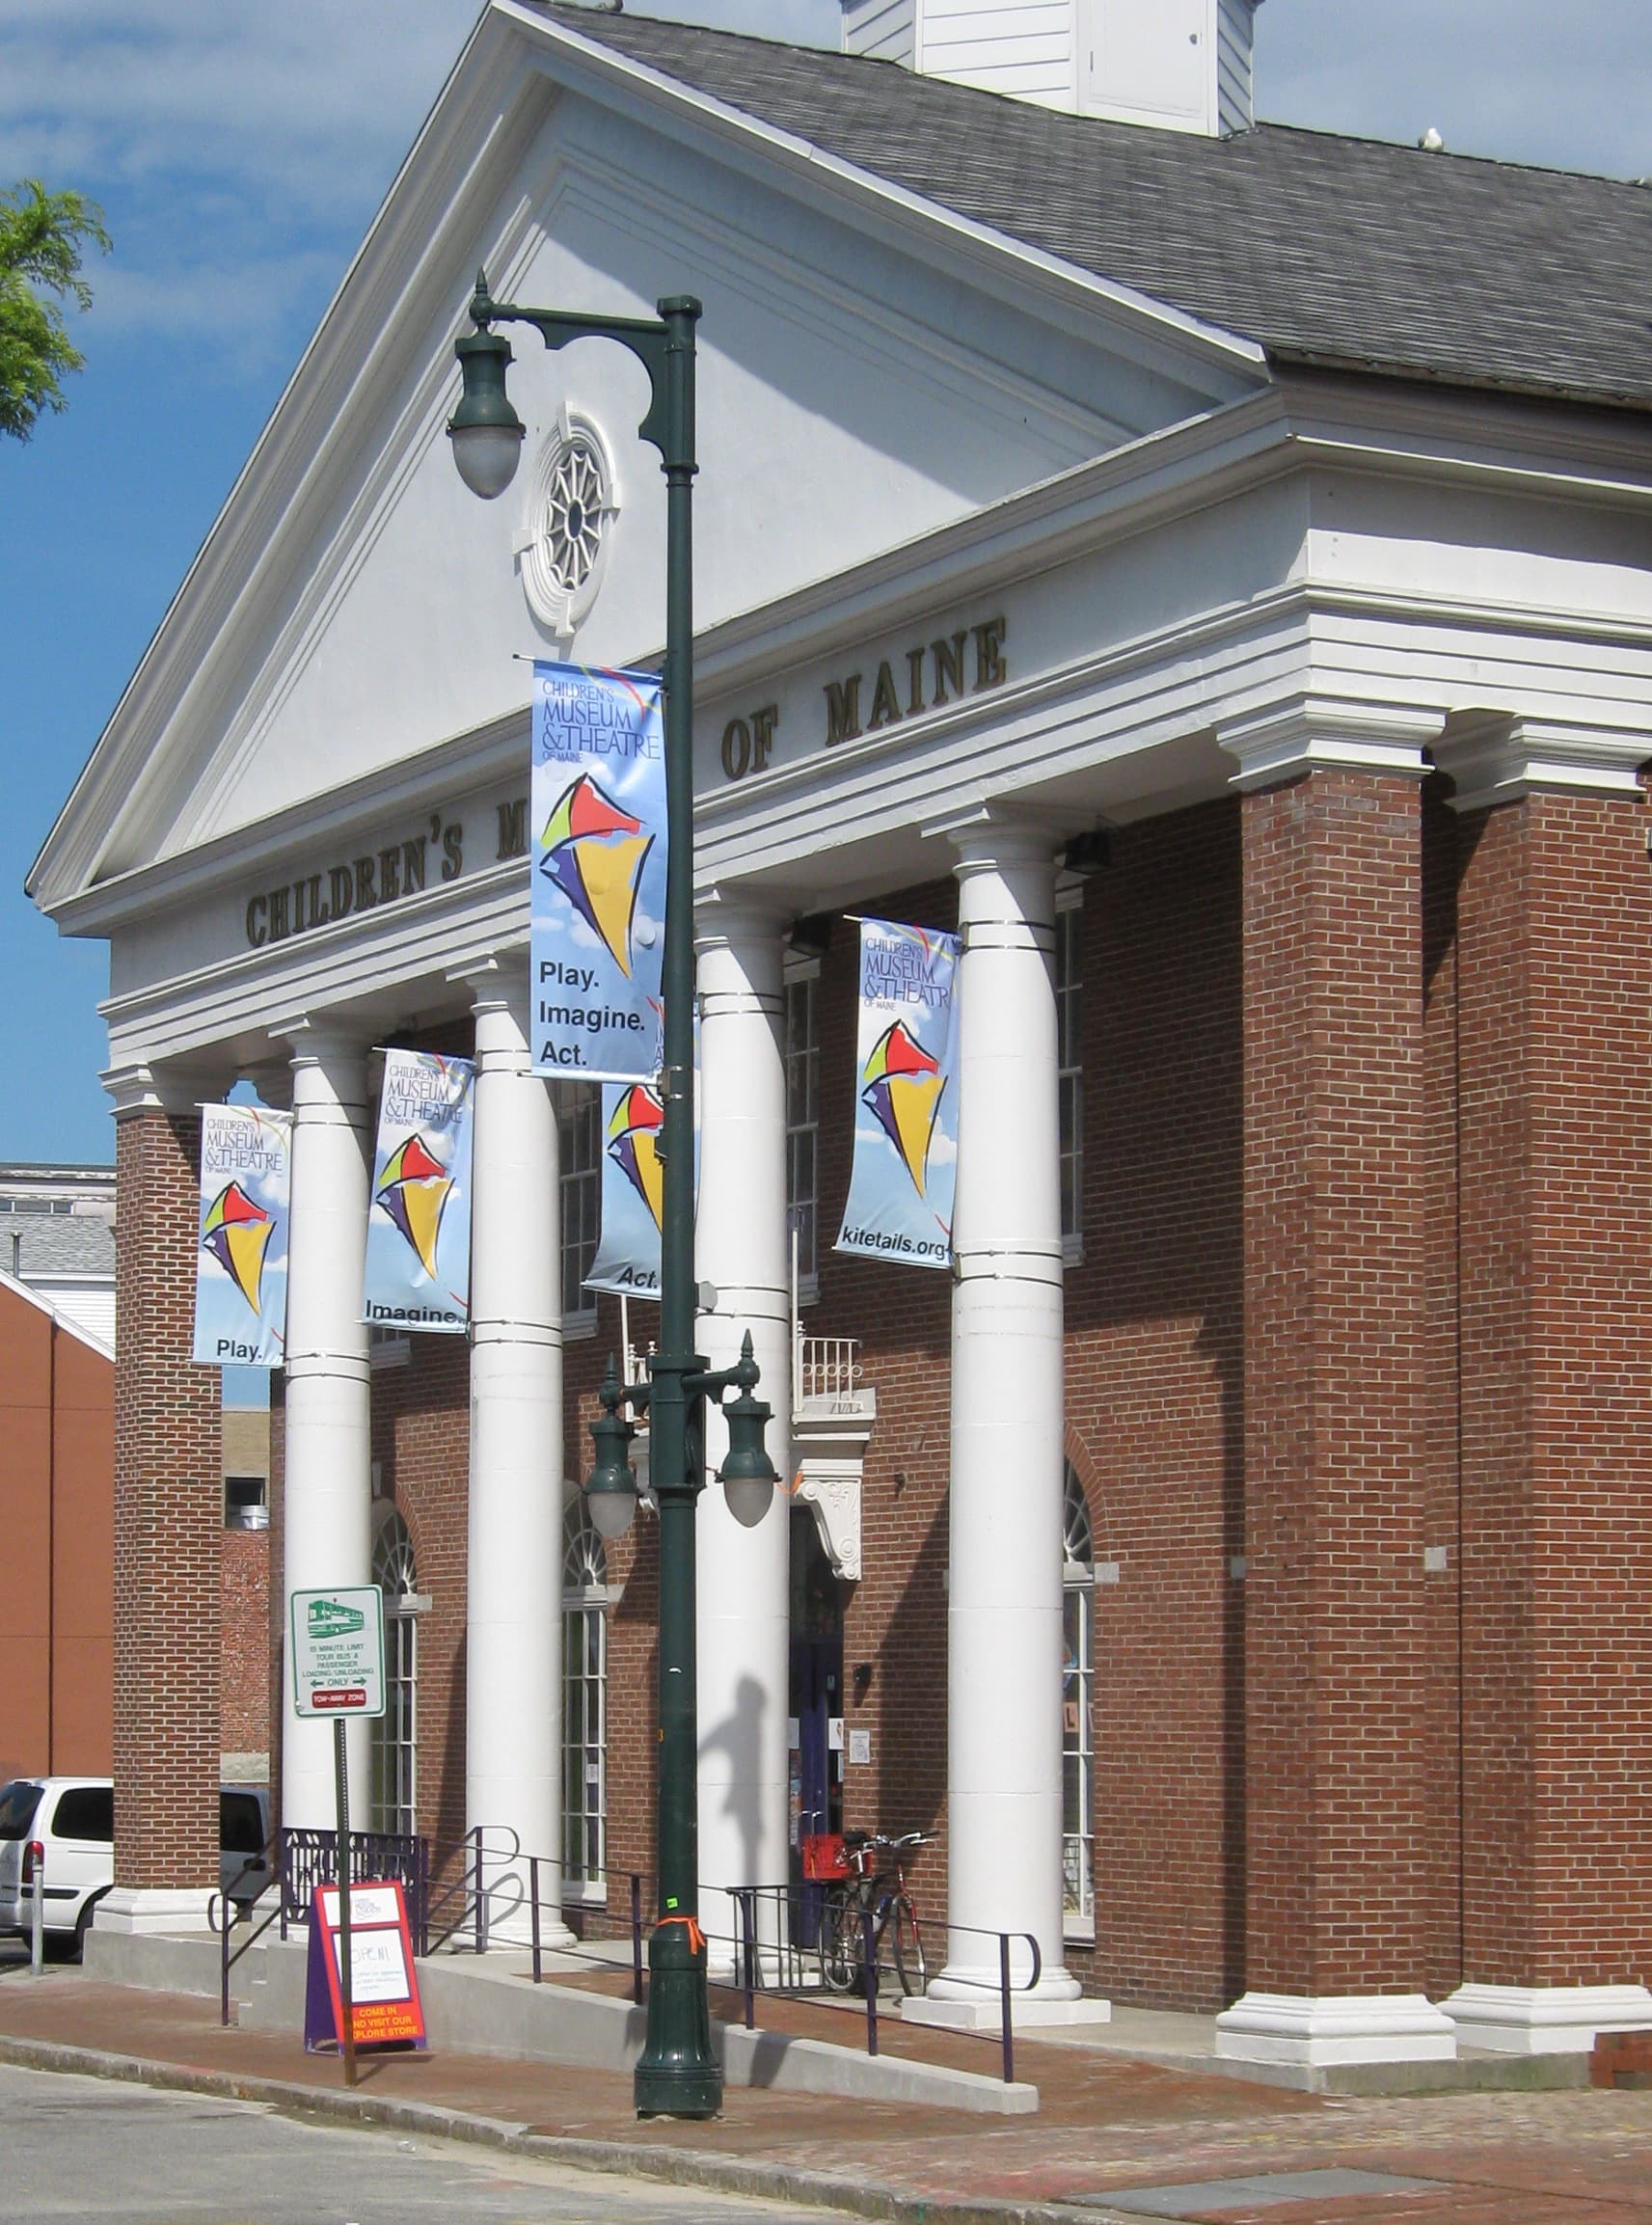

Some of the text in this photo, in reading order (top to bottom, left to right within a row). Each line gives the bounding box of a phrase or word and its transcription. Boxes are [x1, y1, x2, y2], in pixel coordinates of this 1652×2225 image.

[542, 678, 615, 703] CHILDREN'S
[543, 698, 634, 731] MUSEUM
[542, 750, 583, 764] OF MAINE
[246, 813, 464, 948] CHILDREN'S
[721, 703, 779, 780] OF
[823, 614, 1007, 747] MAINE
[540, 961, 600, 992] Play.
[865, 953, 935, 984] MUSEUM
[540, 1000, 645, 1033] Imagine.
[540, 1040, 587, 1066] Act.
[387, 1078, 450, 1102] MUSEUM
[206, 1129, 264, 1151] MUSEUM
[842, 1225, 945, 1262] kitetails.org
[617, 1265, 658, 1289] Act.
[366, 1299, 466, 1326] Imagine.
[216, 1339, 262, 1363] Play.
[327, 1678, 348, 1687] ONLY
[353, 2016, 412, 2029] ND VISIT OUR
[359, 2006, 397, 2018] COME IN
[388, 2025, 418, 2036] STORE
